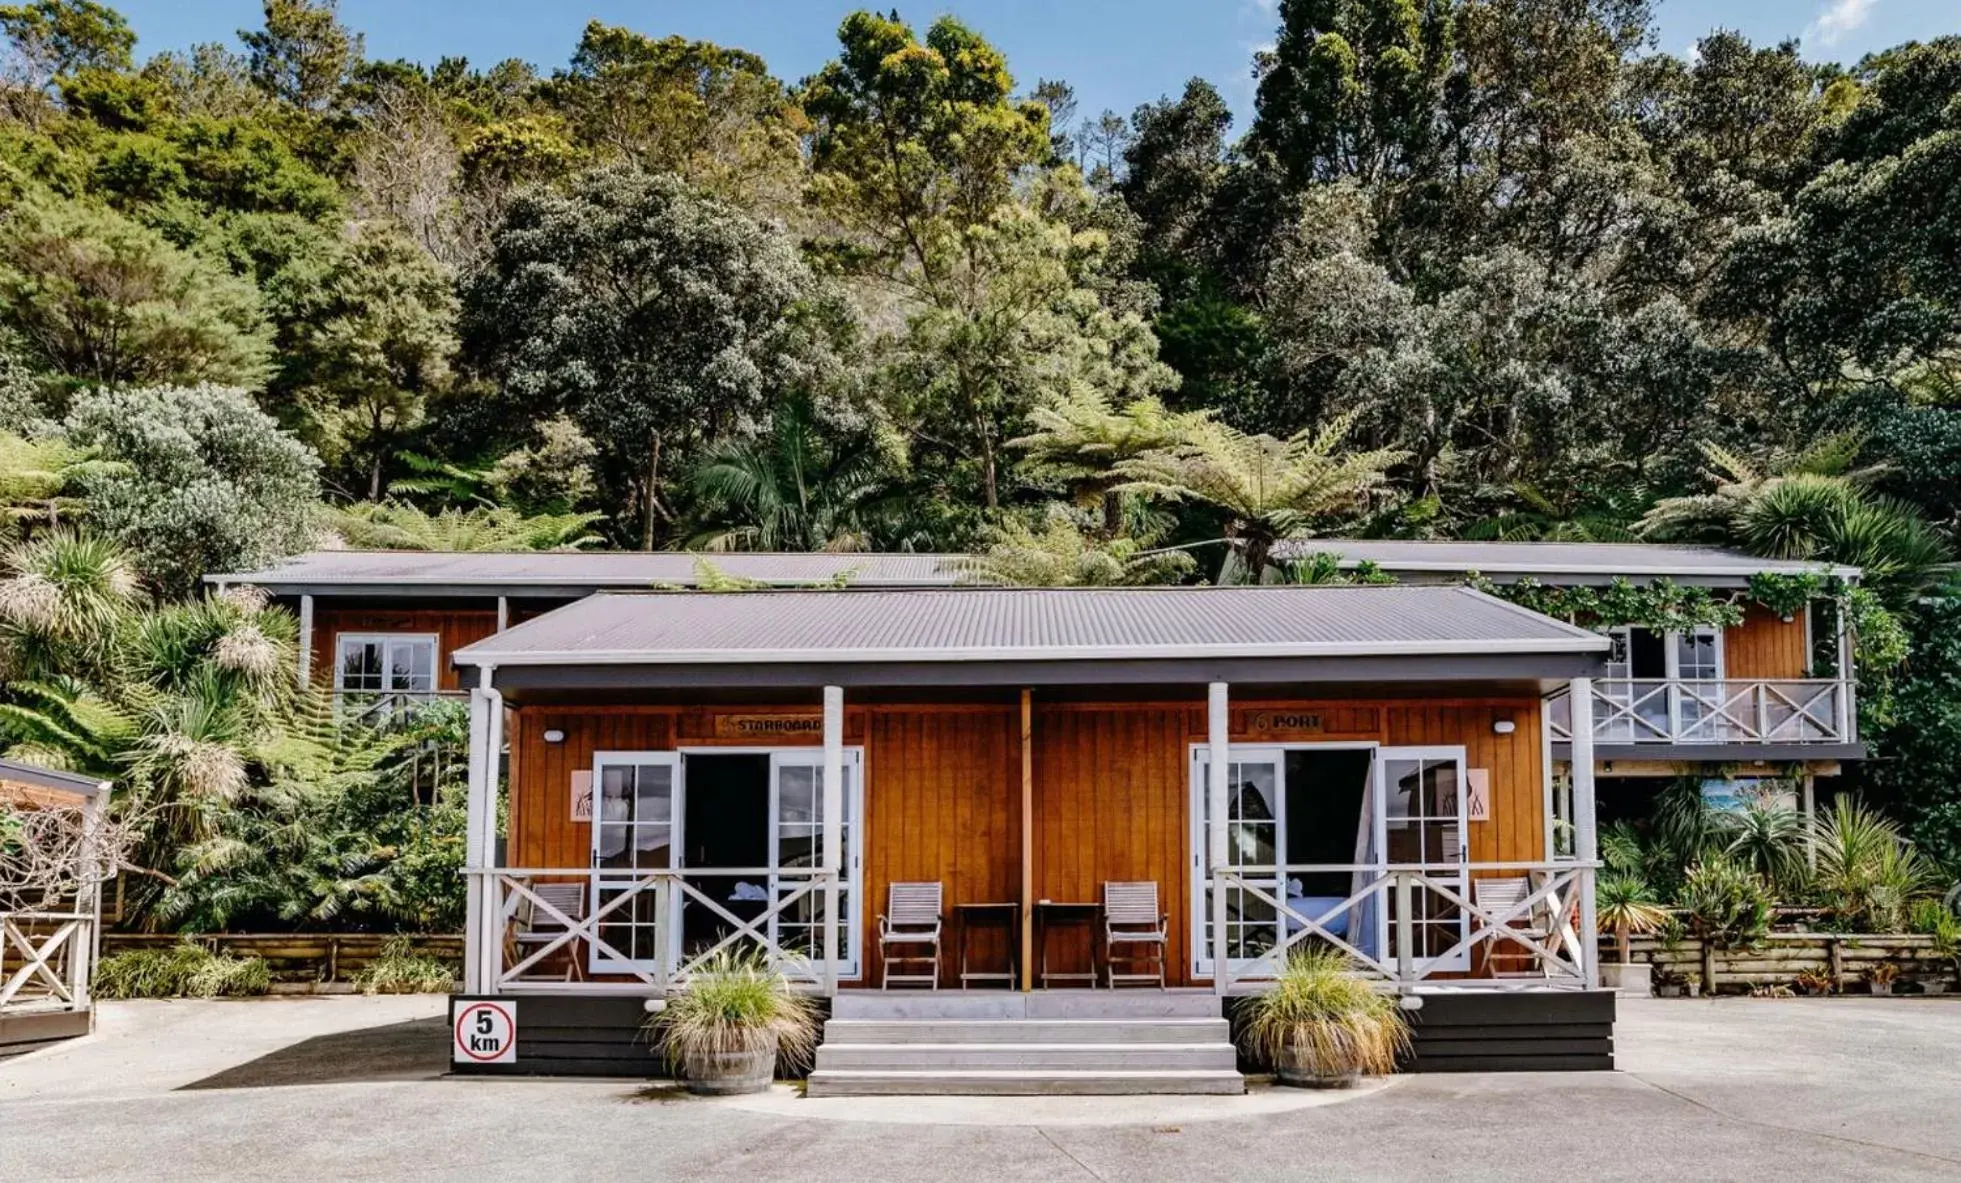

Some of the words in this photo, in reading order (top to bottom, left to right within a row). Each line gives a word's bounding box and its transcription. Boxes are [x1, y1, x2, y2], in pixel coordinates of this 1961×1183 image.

[739, 719, 822, 732] STARBOARD
[1273, 714, 1320, 729] PORT
[476, 1010, 493, 1034] 5
[470, 1034, 499, 1051] km
